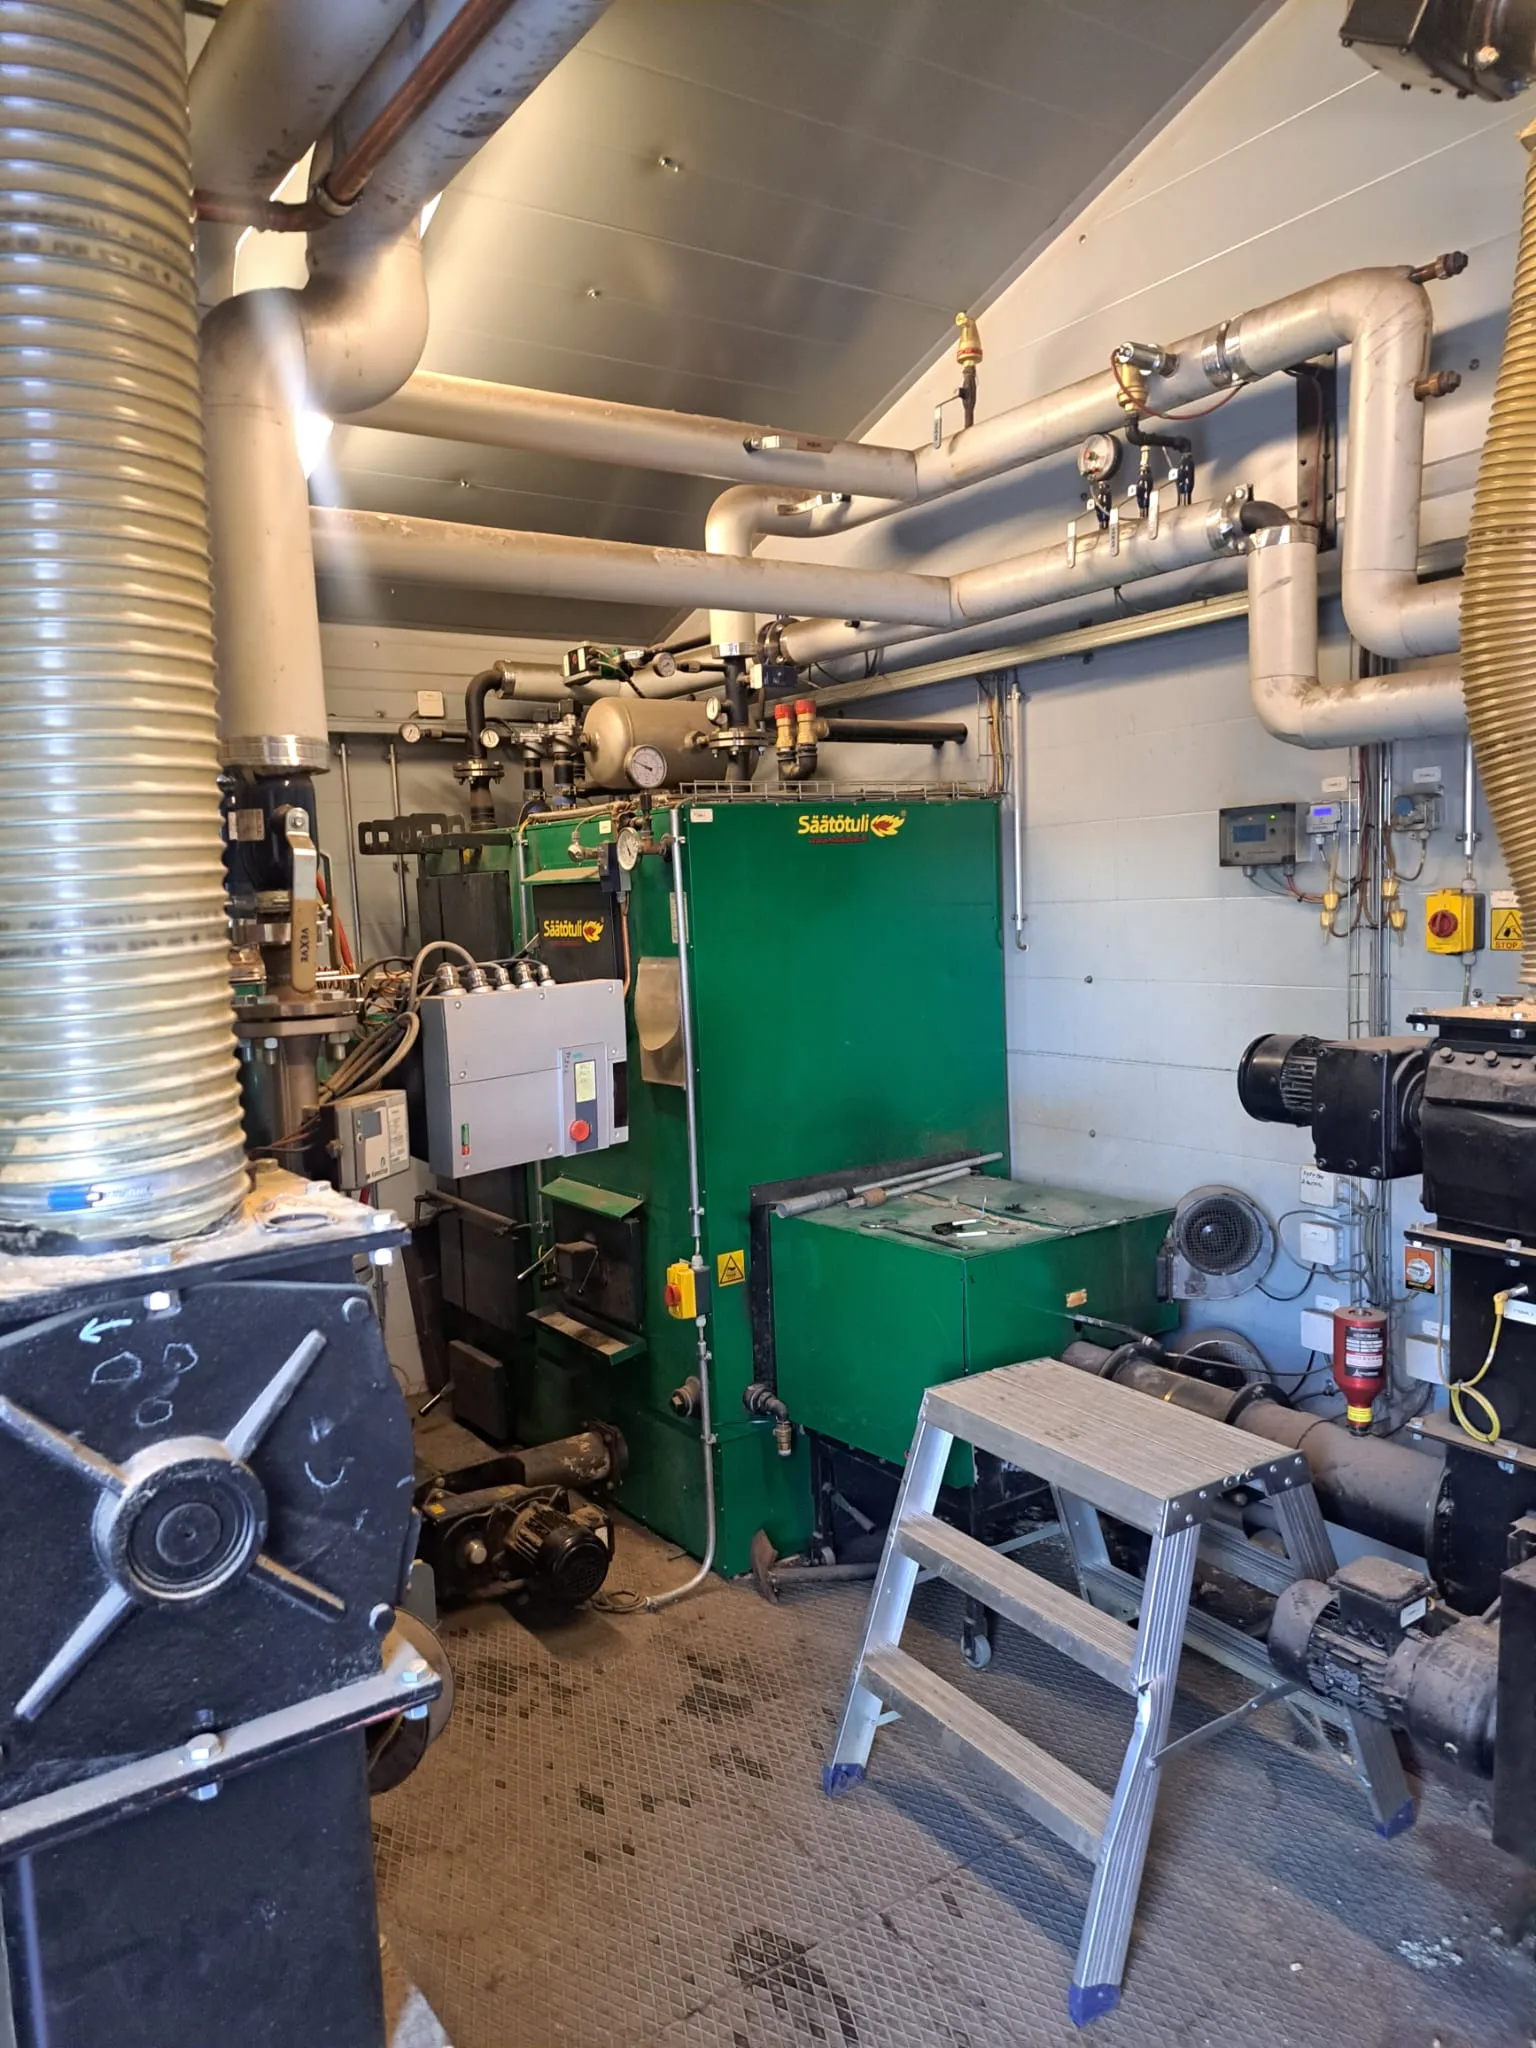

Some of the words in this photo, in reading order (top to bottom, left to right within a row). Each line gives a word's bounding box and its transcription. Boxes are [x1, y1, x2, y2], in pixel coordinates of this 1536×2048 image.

[797, 813, 870, 834] Säätötuli
[543, 919, 583, 937] Säätötuli
[1495, 940, 1518, 949] STOP
